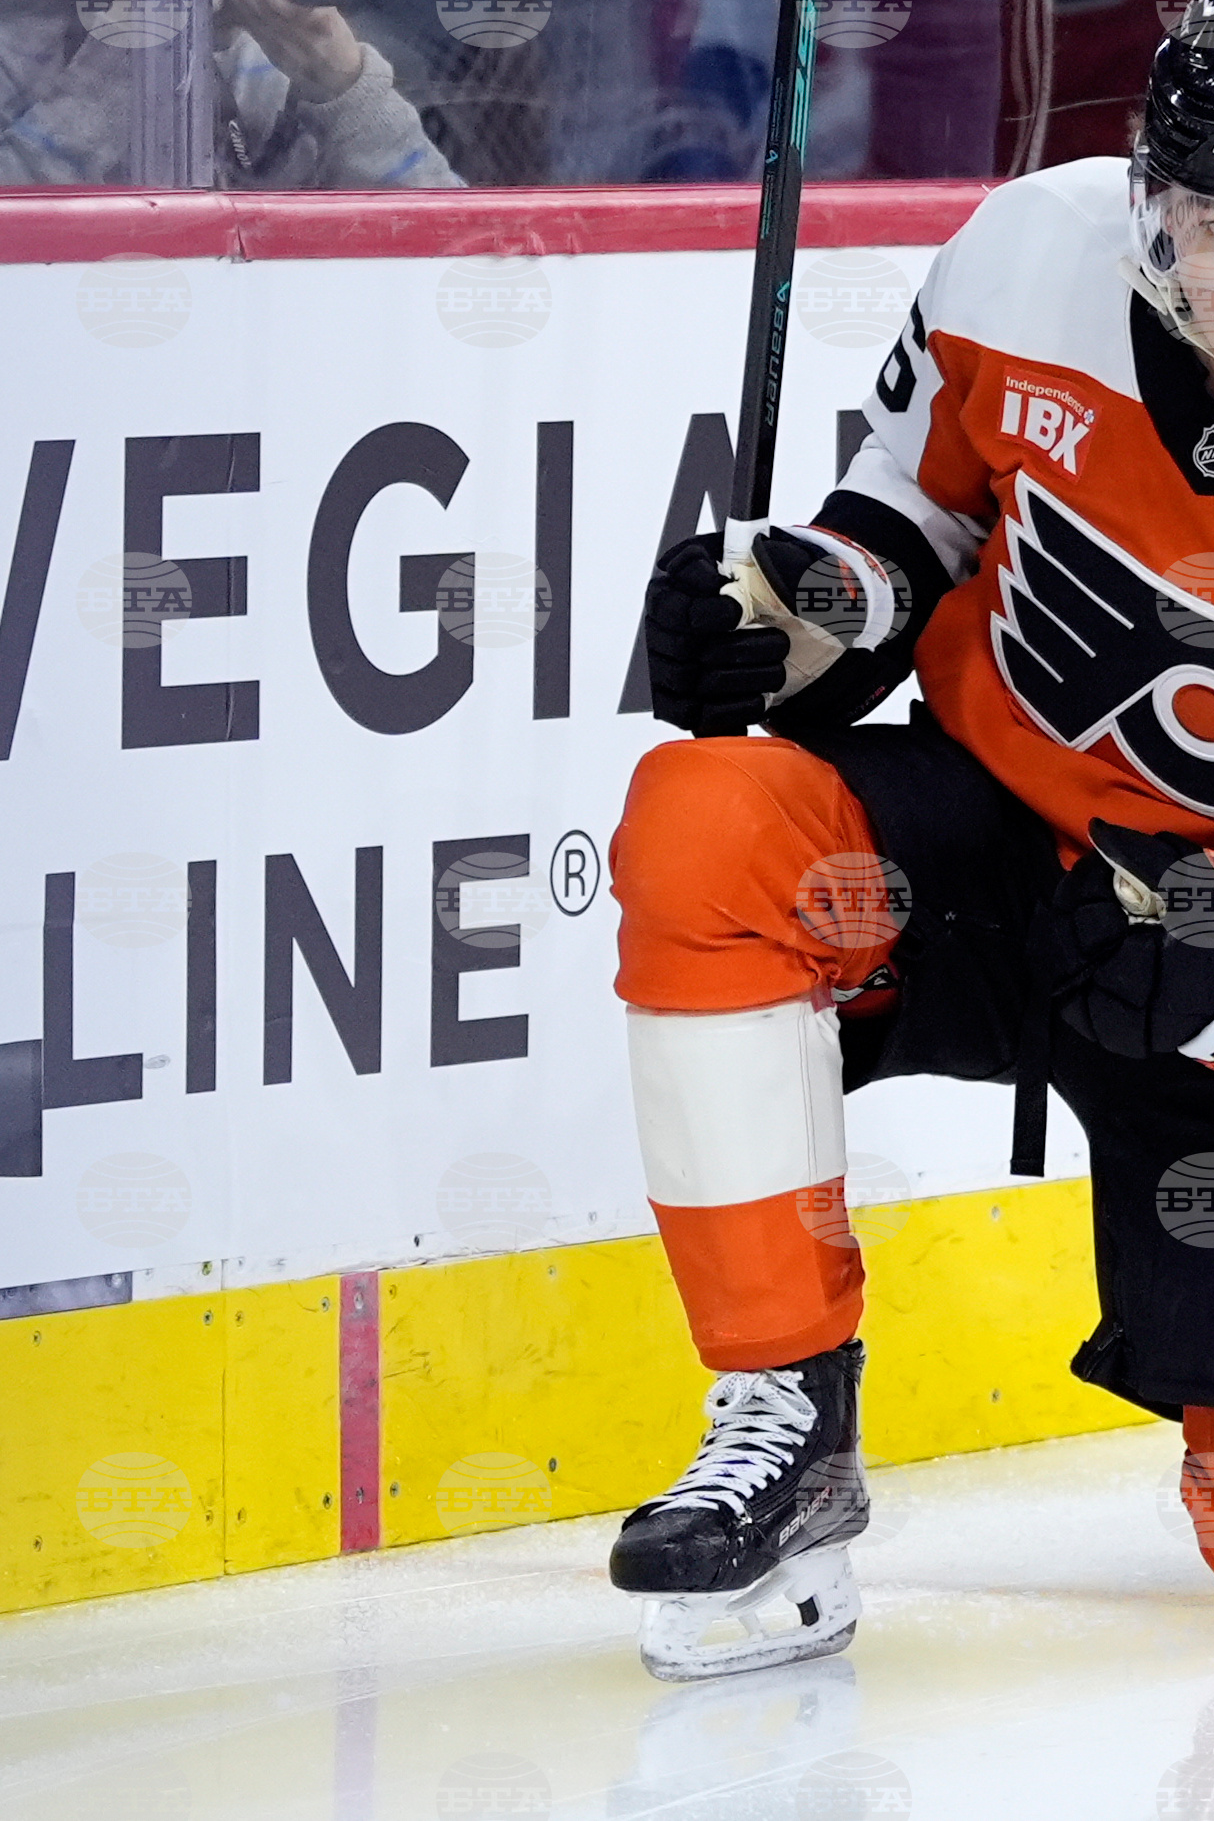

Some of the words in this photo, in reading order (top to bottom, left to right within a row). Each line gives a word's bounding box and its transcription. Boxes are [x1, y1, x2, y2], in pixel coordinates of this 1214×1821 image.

[766, 305, 785, 428] BAUER
[1005, 376, 1085, 417] Independence
[1000, 389, 1091, 476] IBX
[778, 1485, 831, 1547] BAUER
